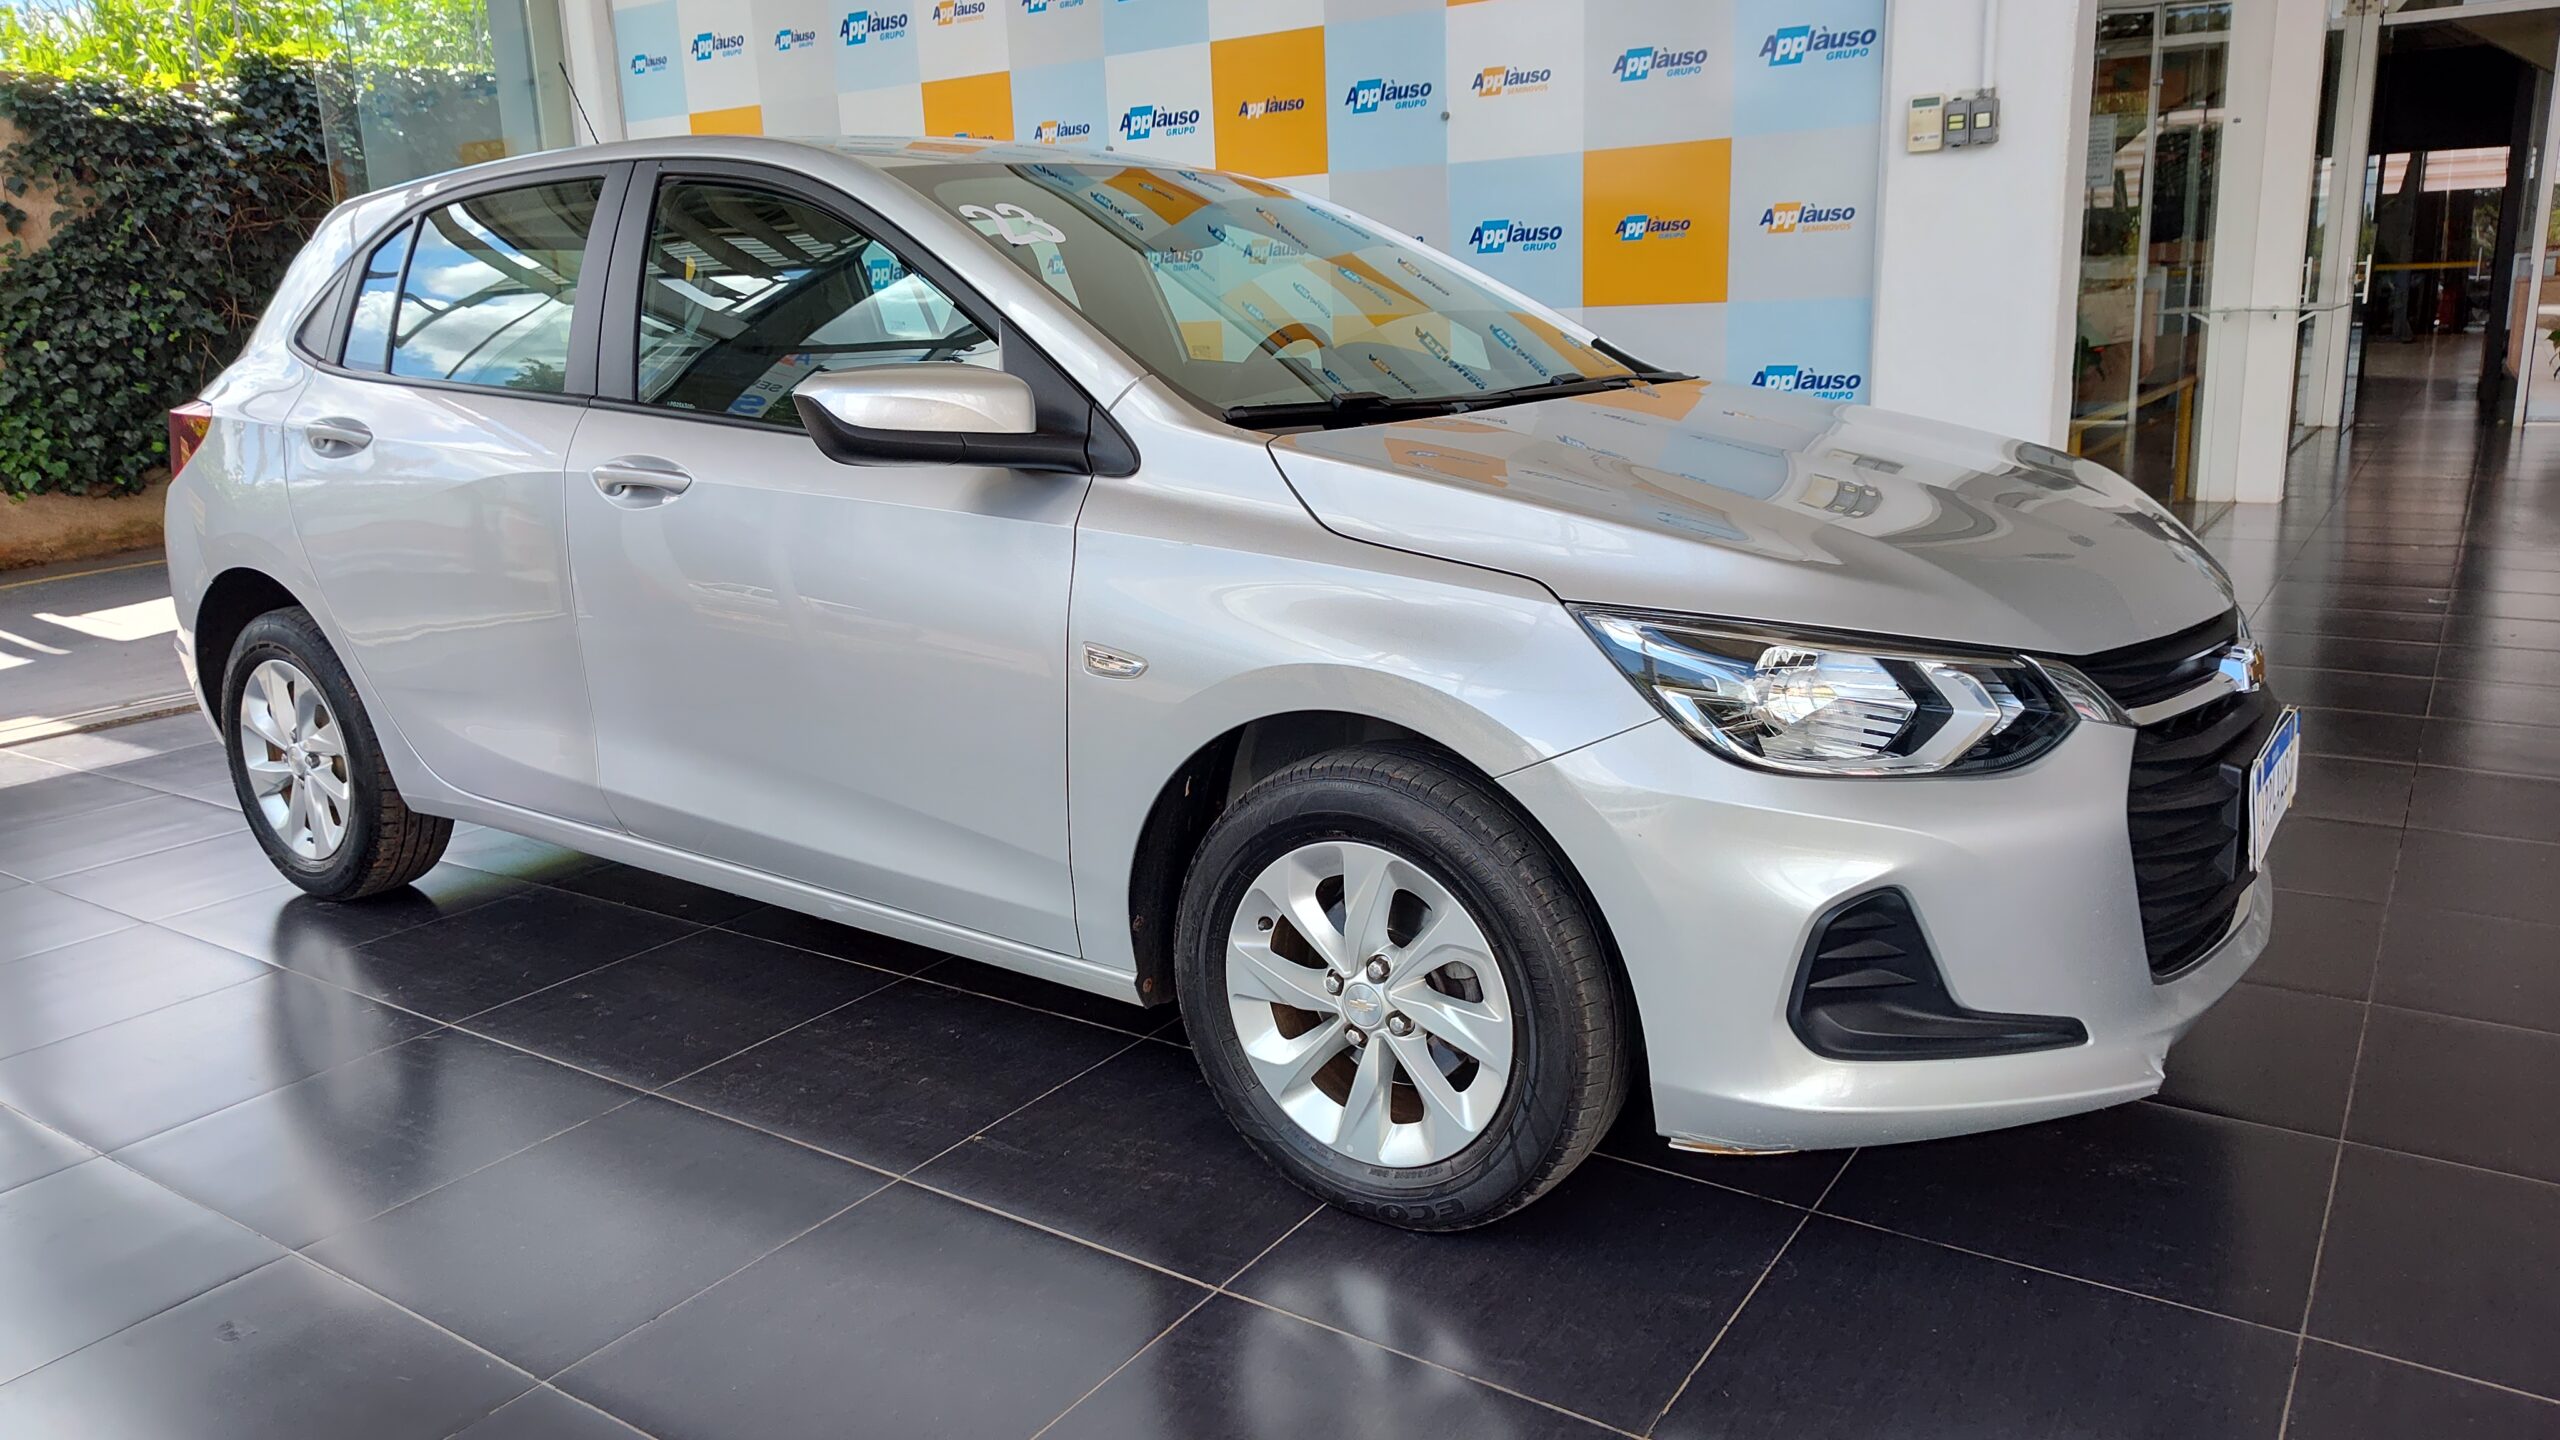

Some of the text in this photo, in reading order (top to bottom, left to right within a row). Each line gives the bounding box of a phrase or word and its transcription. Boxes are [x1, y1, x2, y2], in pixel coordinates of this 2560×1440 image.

[840, 11, 908, 41] Applàuso
[879, 30, 905, 41] GRUPO
[691, 33, 744, 58] Applàuso
[1759, 26, 1877, 65] Applàuso
[1825, 47, 1870, 61] GRUPO
[1612, 47, 1708, 80] Applàuso
[1666, 65, 1702, 78] GRUPO
[1471, 67, 1552, 94] Applàuso
[1238, 96, 1305, 119] Applàuso
[1344, 80, 1432, 112] Applàuso
[1394, 98, 1427, 110] GRUPO
[1119, 106, 1200, 136] Applàuso
[1166, 126, 1196, 137] GRUPO
[1615, 216, 1691, 239] Applàuso
[1759, 203, 1856, 230] Applàuso
[1468, 220, 1563, 252] Applàuso
[1522, 241, 1557, 252] GRUPO
